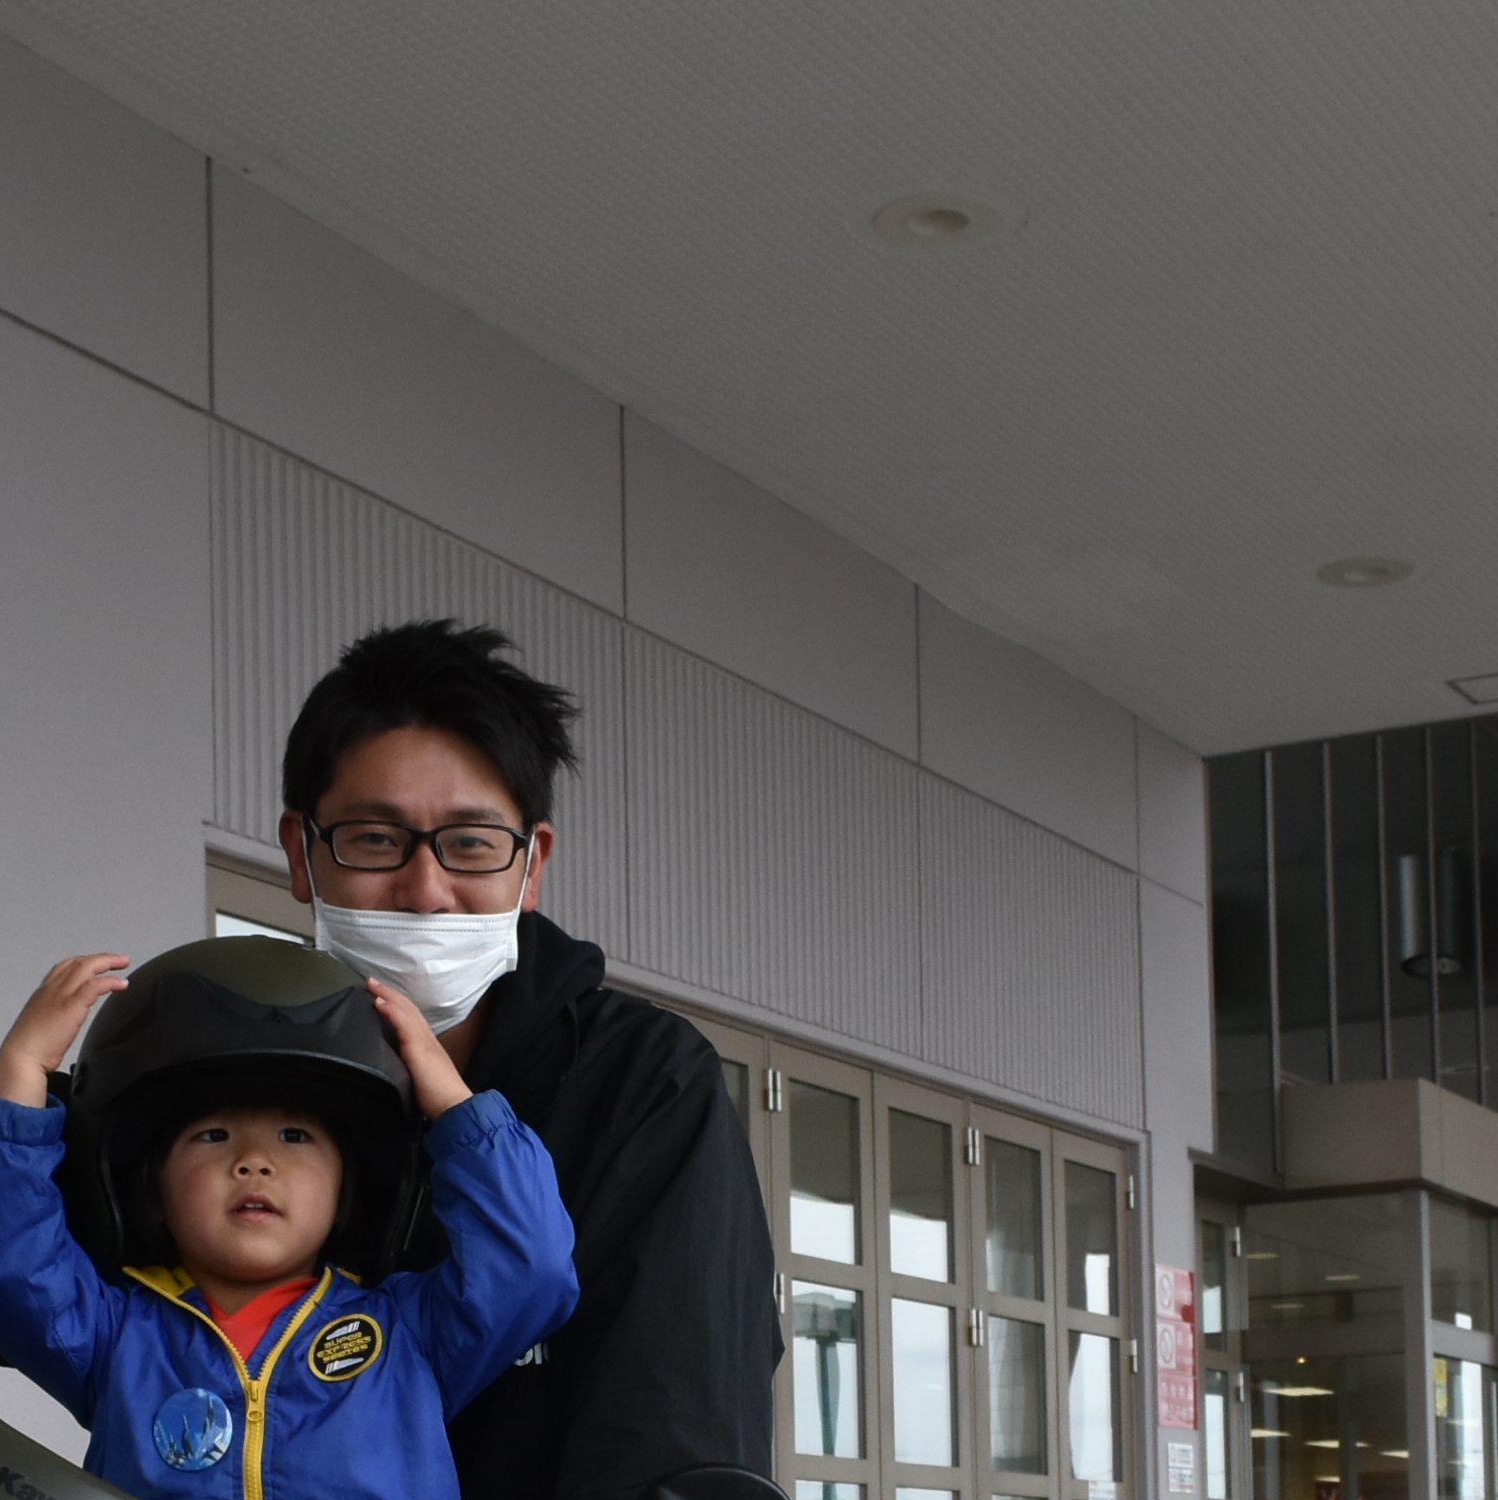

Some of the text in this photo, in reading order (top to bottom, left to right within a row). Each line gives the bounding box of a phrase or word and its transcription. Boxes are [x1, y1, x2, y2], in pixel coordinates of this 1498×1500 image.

[316, 1335, 372, 1358] EXPRESS
[323, 1331, 363, 1349] SUPER
[322, 1344, 369, 1363] SERIES
